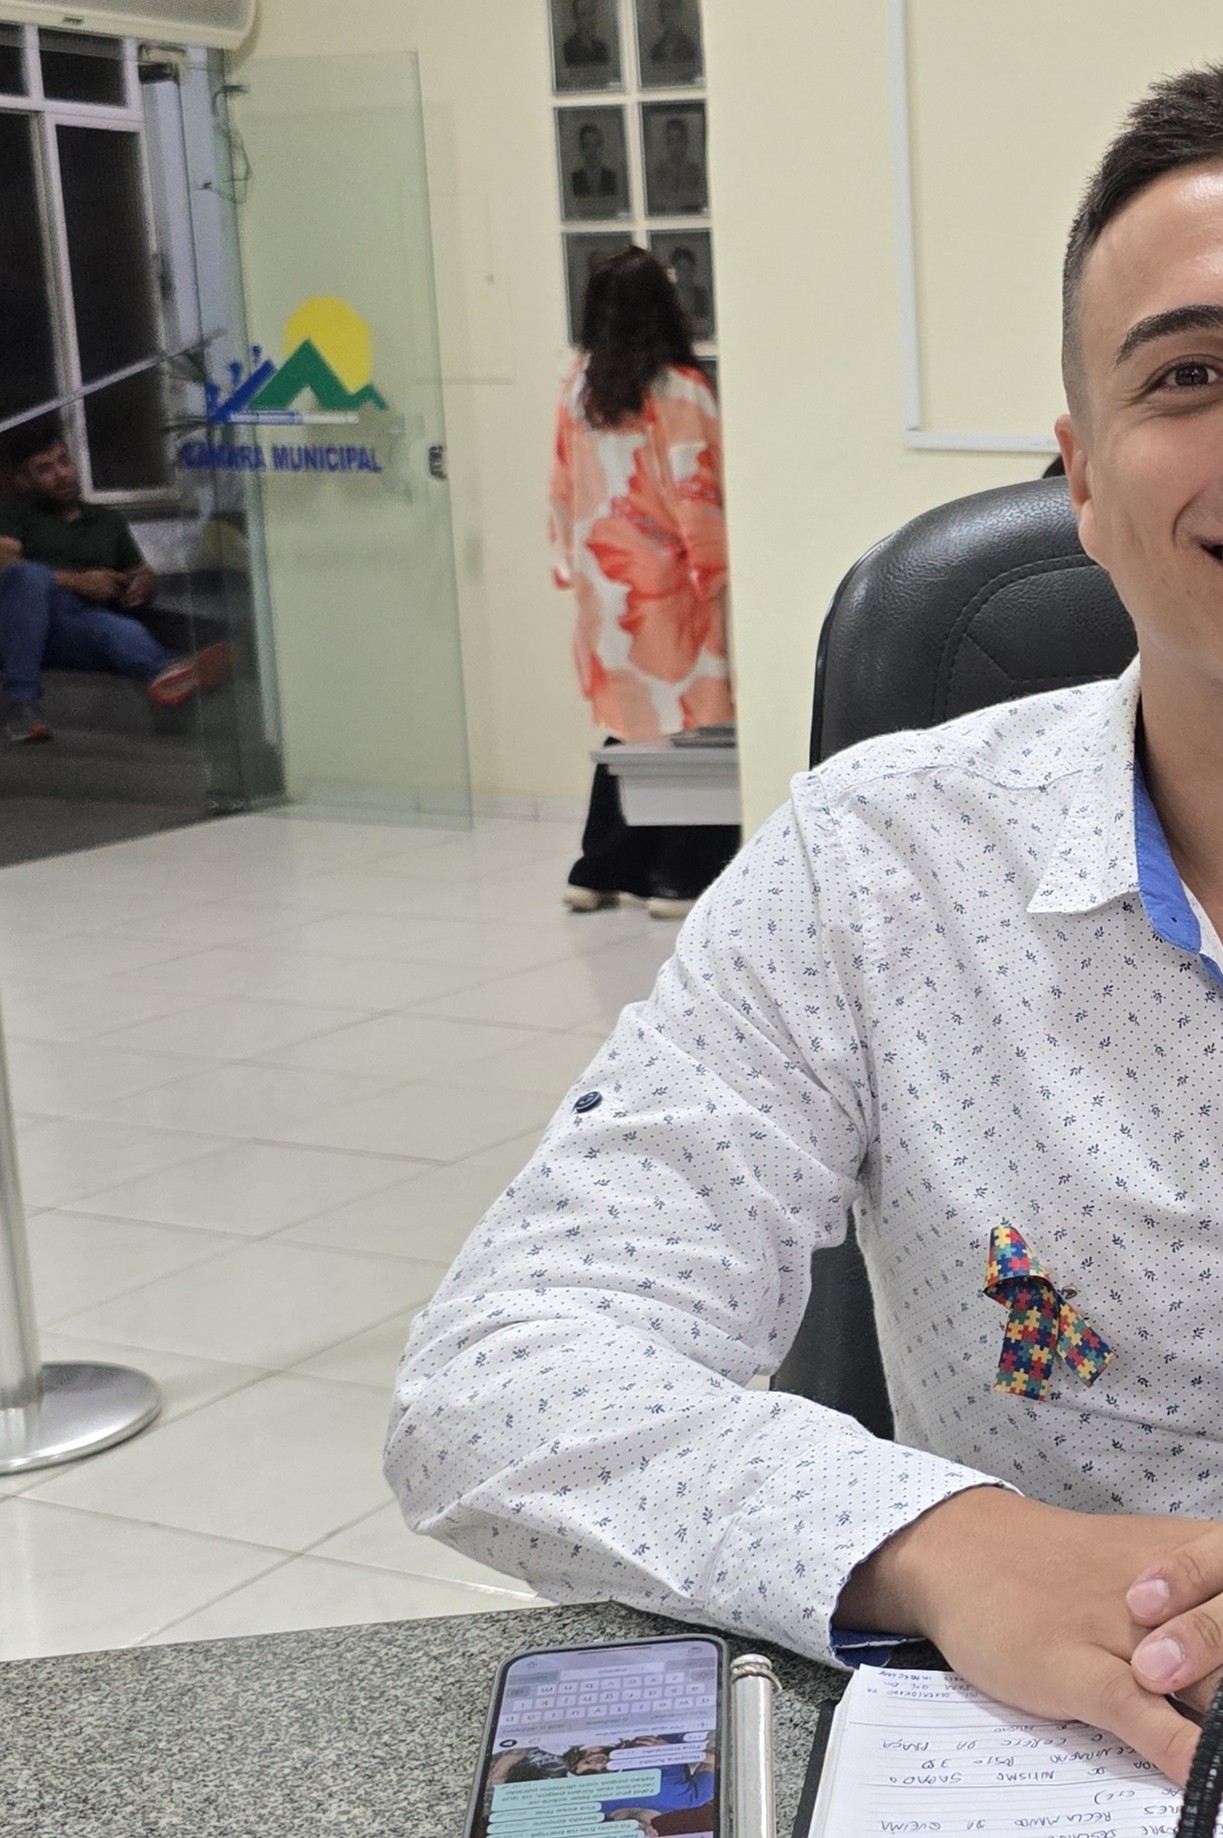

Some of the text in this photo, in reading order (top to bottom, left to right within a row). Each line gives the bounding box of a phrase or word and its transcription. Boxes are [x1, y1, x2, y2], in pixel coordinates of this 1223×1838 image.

[272, 444, 383, 473] MUNICIPAL
[996, 1770, 1055, 1780] AUTISMO
[881, 1820, 941, 1834] QUEIMA
